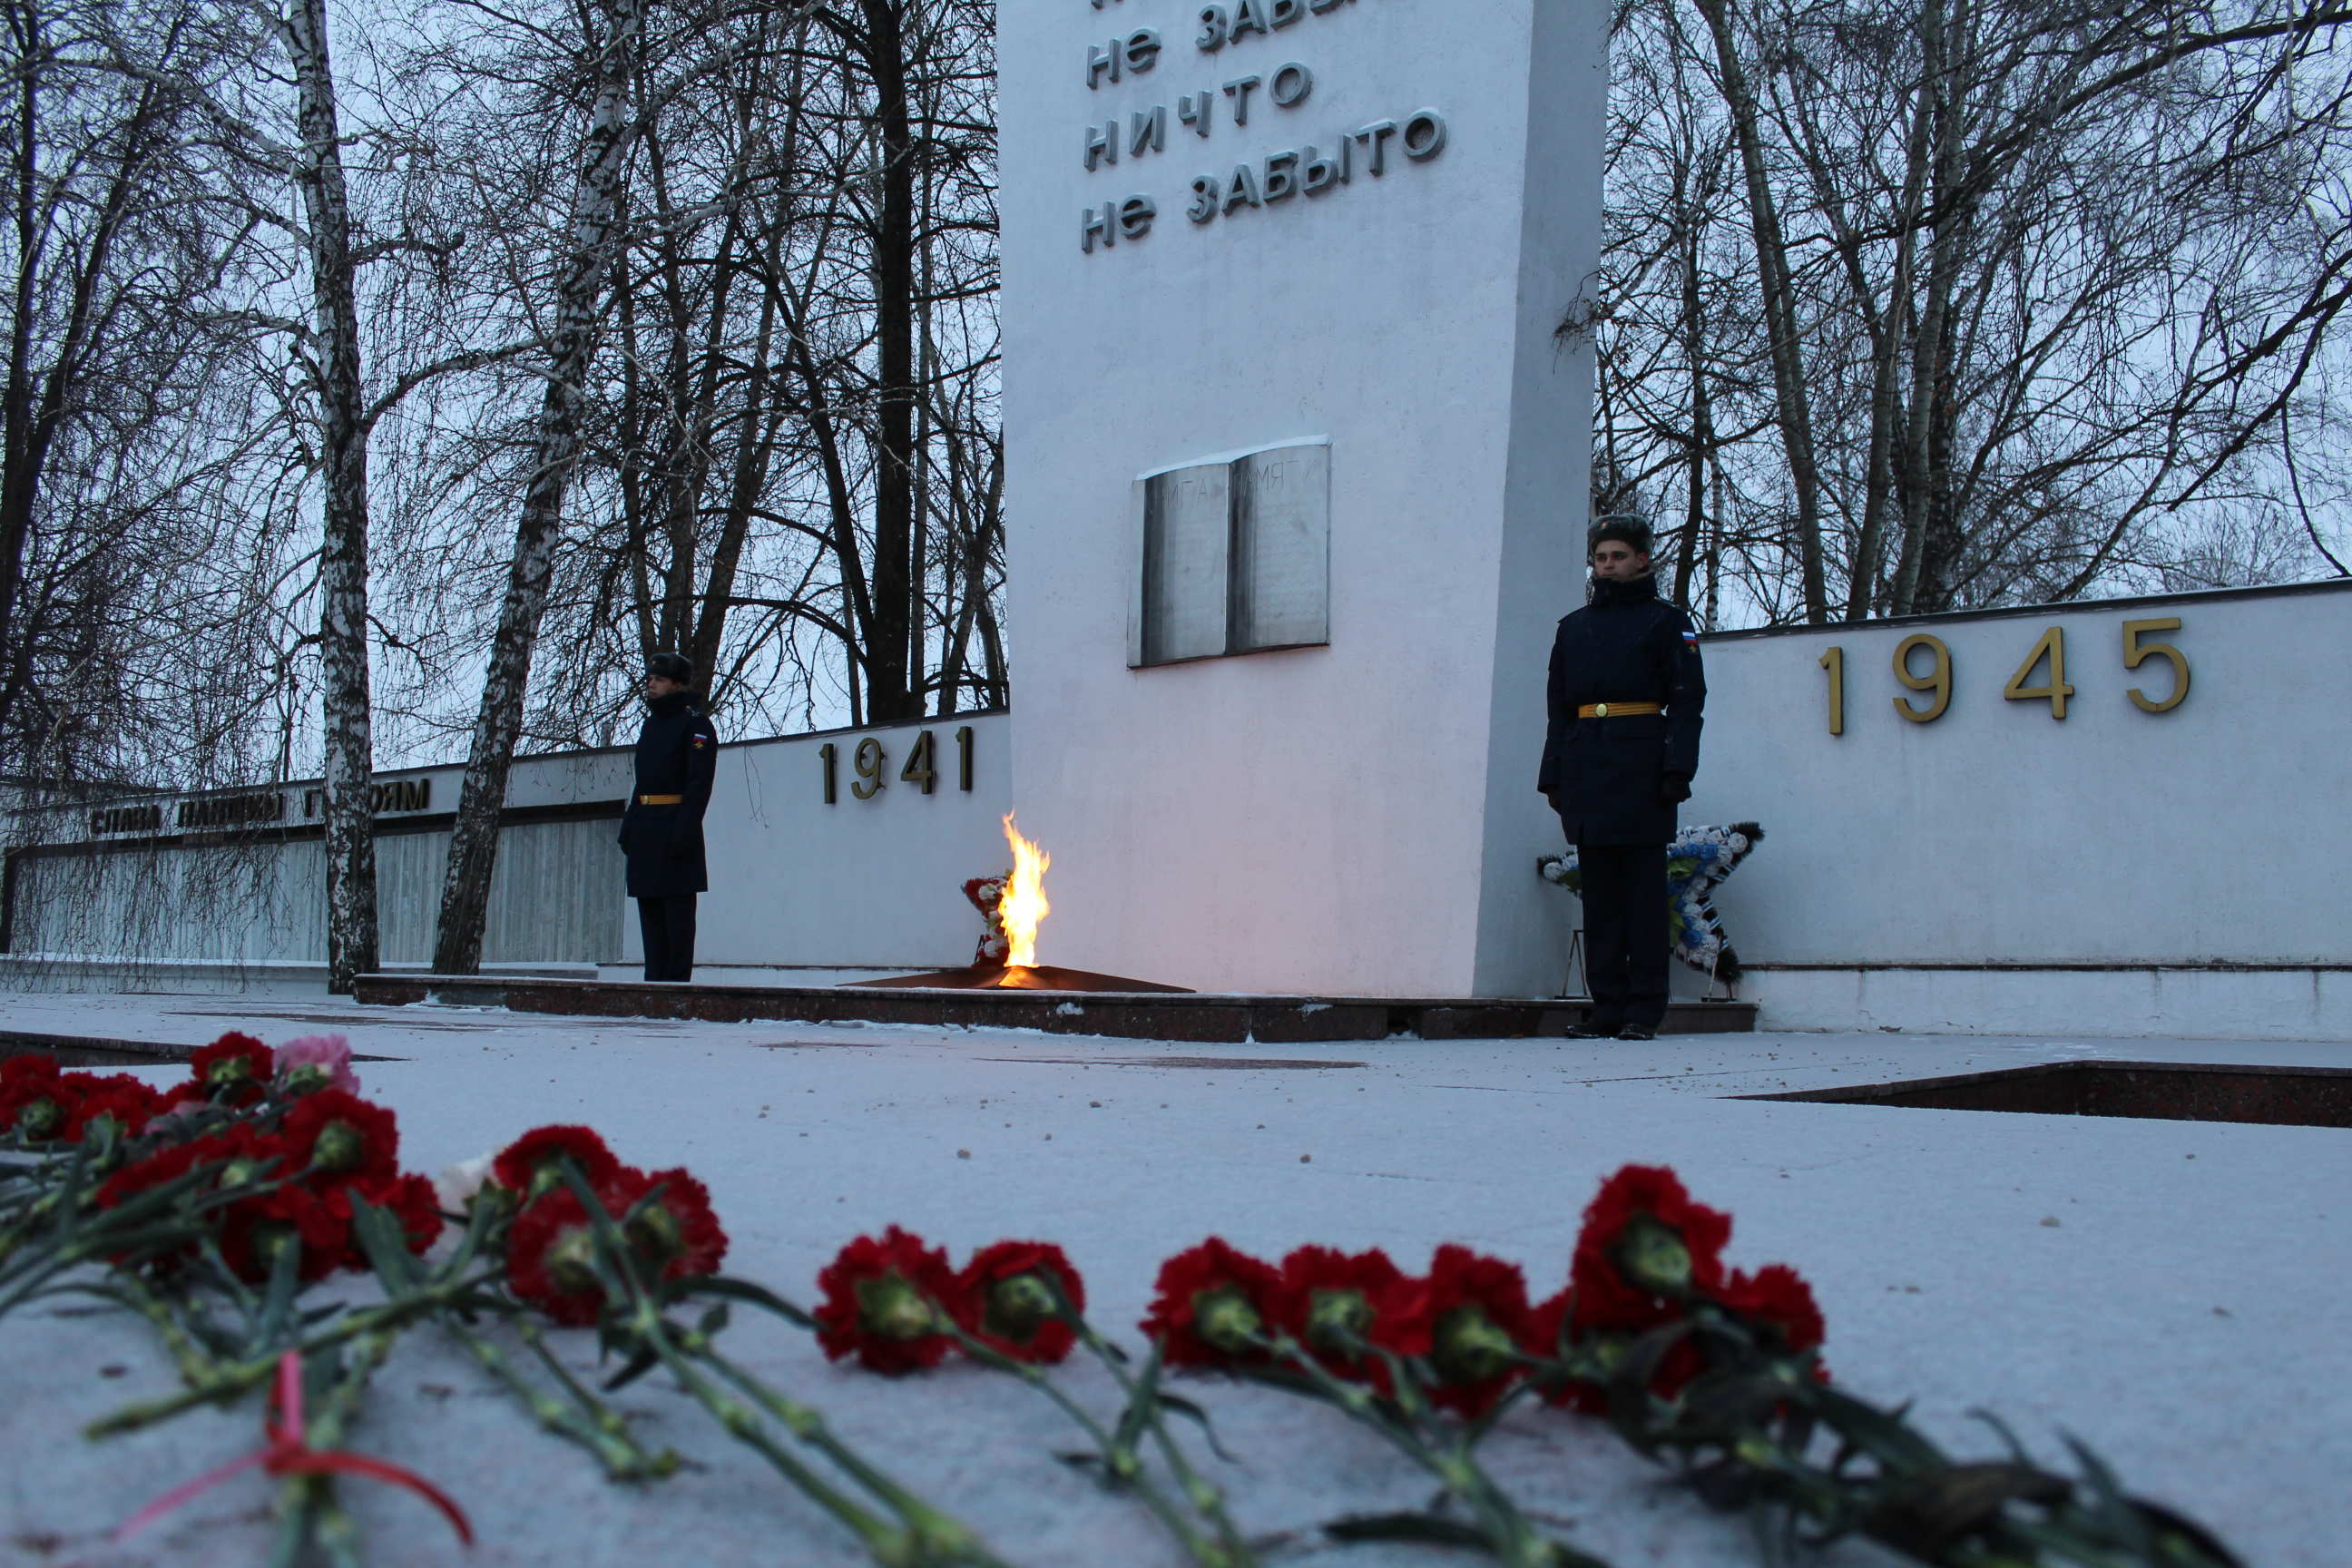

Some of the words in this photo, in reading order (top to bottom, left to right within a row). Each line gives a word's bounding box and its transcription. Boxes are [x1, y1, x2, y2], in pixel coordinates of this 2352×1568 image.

[1084, 61, 1313, 172] НИЧТО
[1186, 109, 1447, 225] ЗАБЫТО
[1145, 478, 1209, 515] КНИГА
[1233, 458, 1317, 498] ПАМЯТИ
[1818, 616, 2190, 736] 1945
[818, 725, 974, 805] 1941
